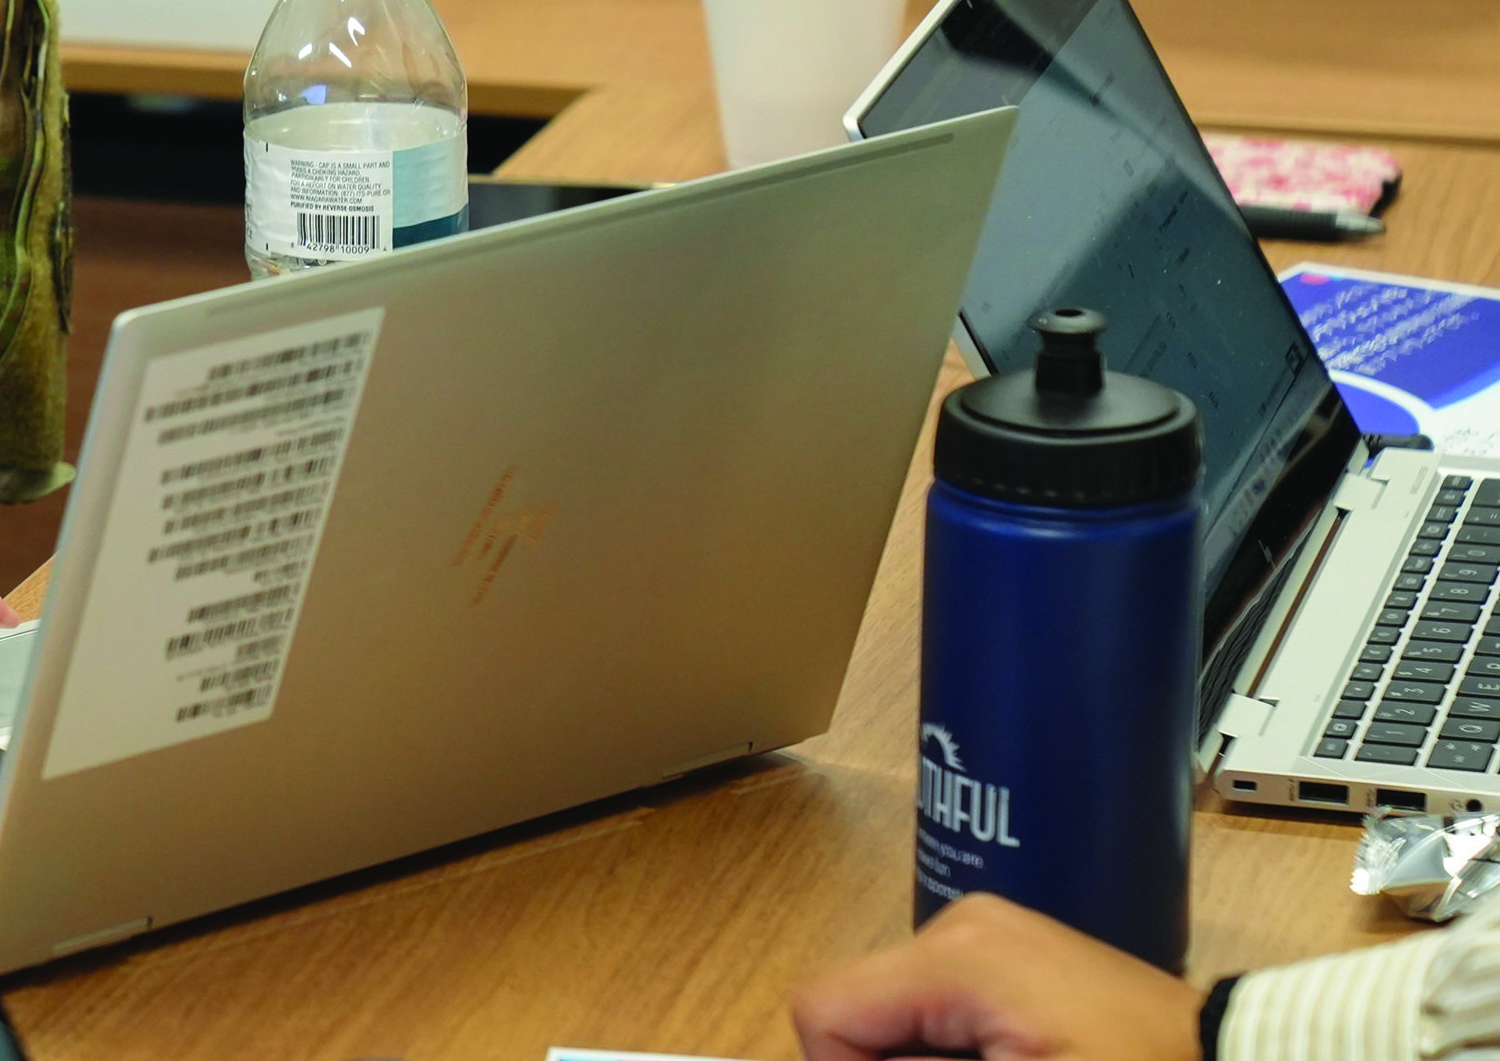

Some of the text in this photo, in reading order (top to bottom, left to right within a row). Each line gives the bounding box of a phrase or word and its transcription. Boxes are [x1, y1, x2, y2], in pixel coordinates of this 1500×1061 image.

[379, 161, 391, 169] AND
[290, 201, 314, 209] PURIFIED
[315, 202, 322, 210] BY
[306, 242, 335, 253] 42798
[341, 244, 370, 254] 10009
